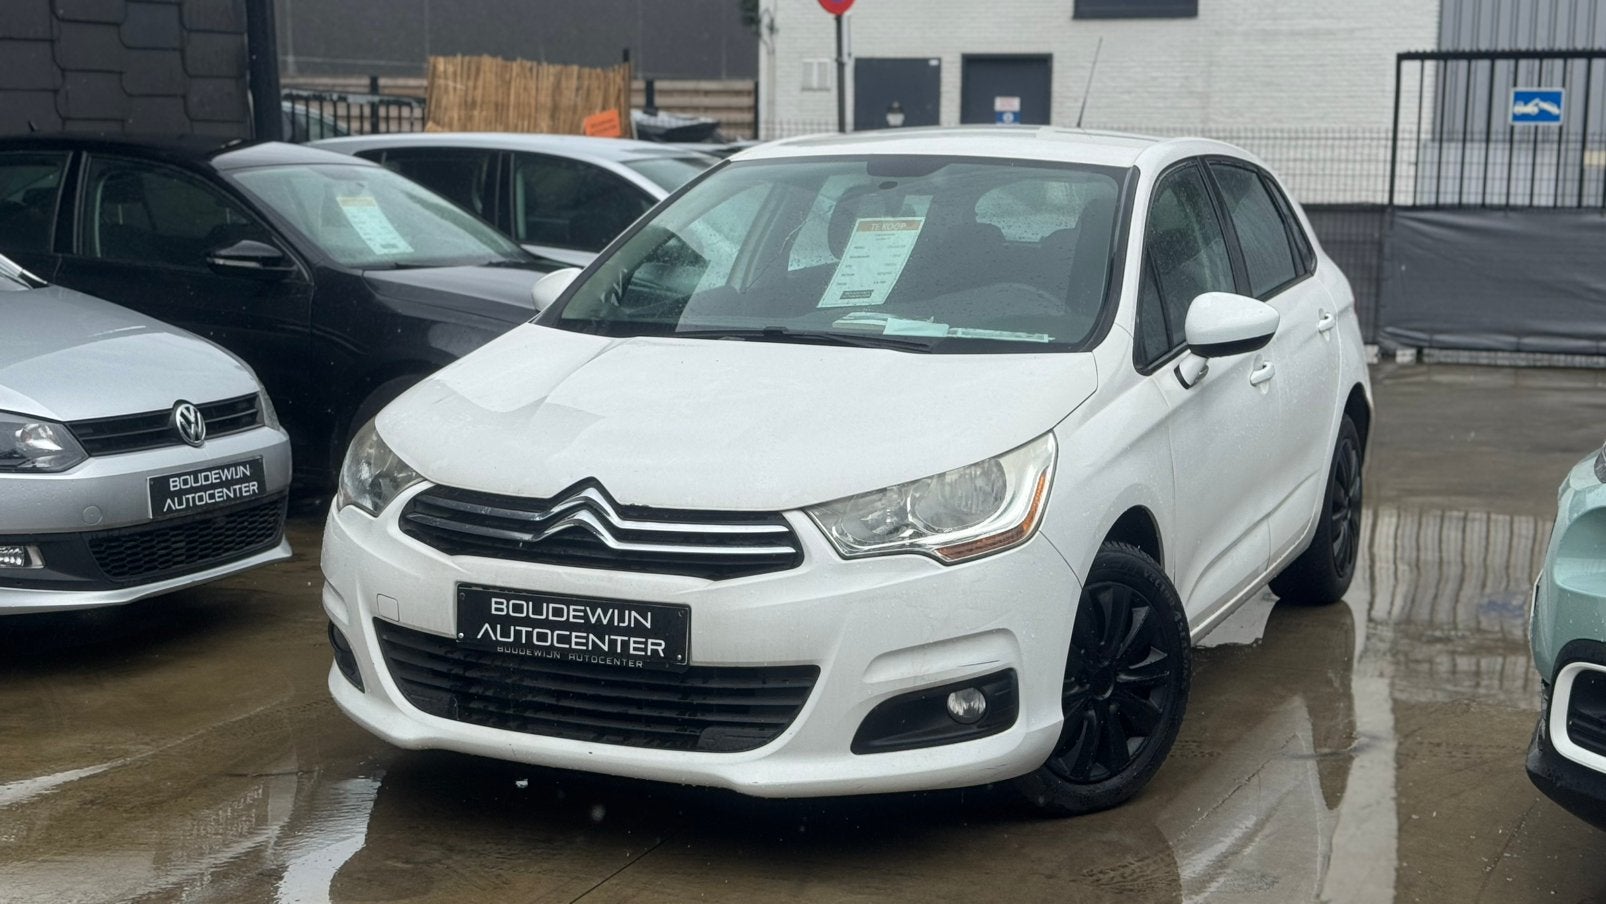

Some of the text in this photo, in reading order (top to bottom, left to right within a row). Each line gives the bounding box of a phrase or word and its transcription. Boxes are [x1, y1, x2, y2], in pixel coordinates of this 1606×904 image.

[169, 464, 250, 491] BOUDEWIJN
[163, 481, 258, 512] AUTOCENTER
[491, 597, 651, 629] BOUDEWIJN
[477, 623, 666, 657] AUTOCENTER
[497, 646, 643, 668] BOUDEWIJN AUTOCENTER
